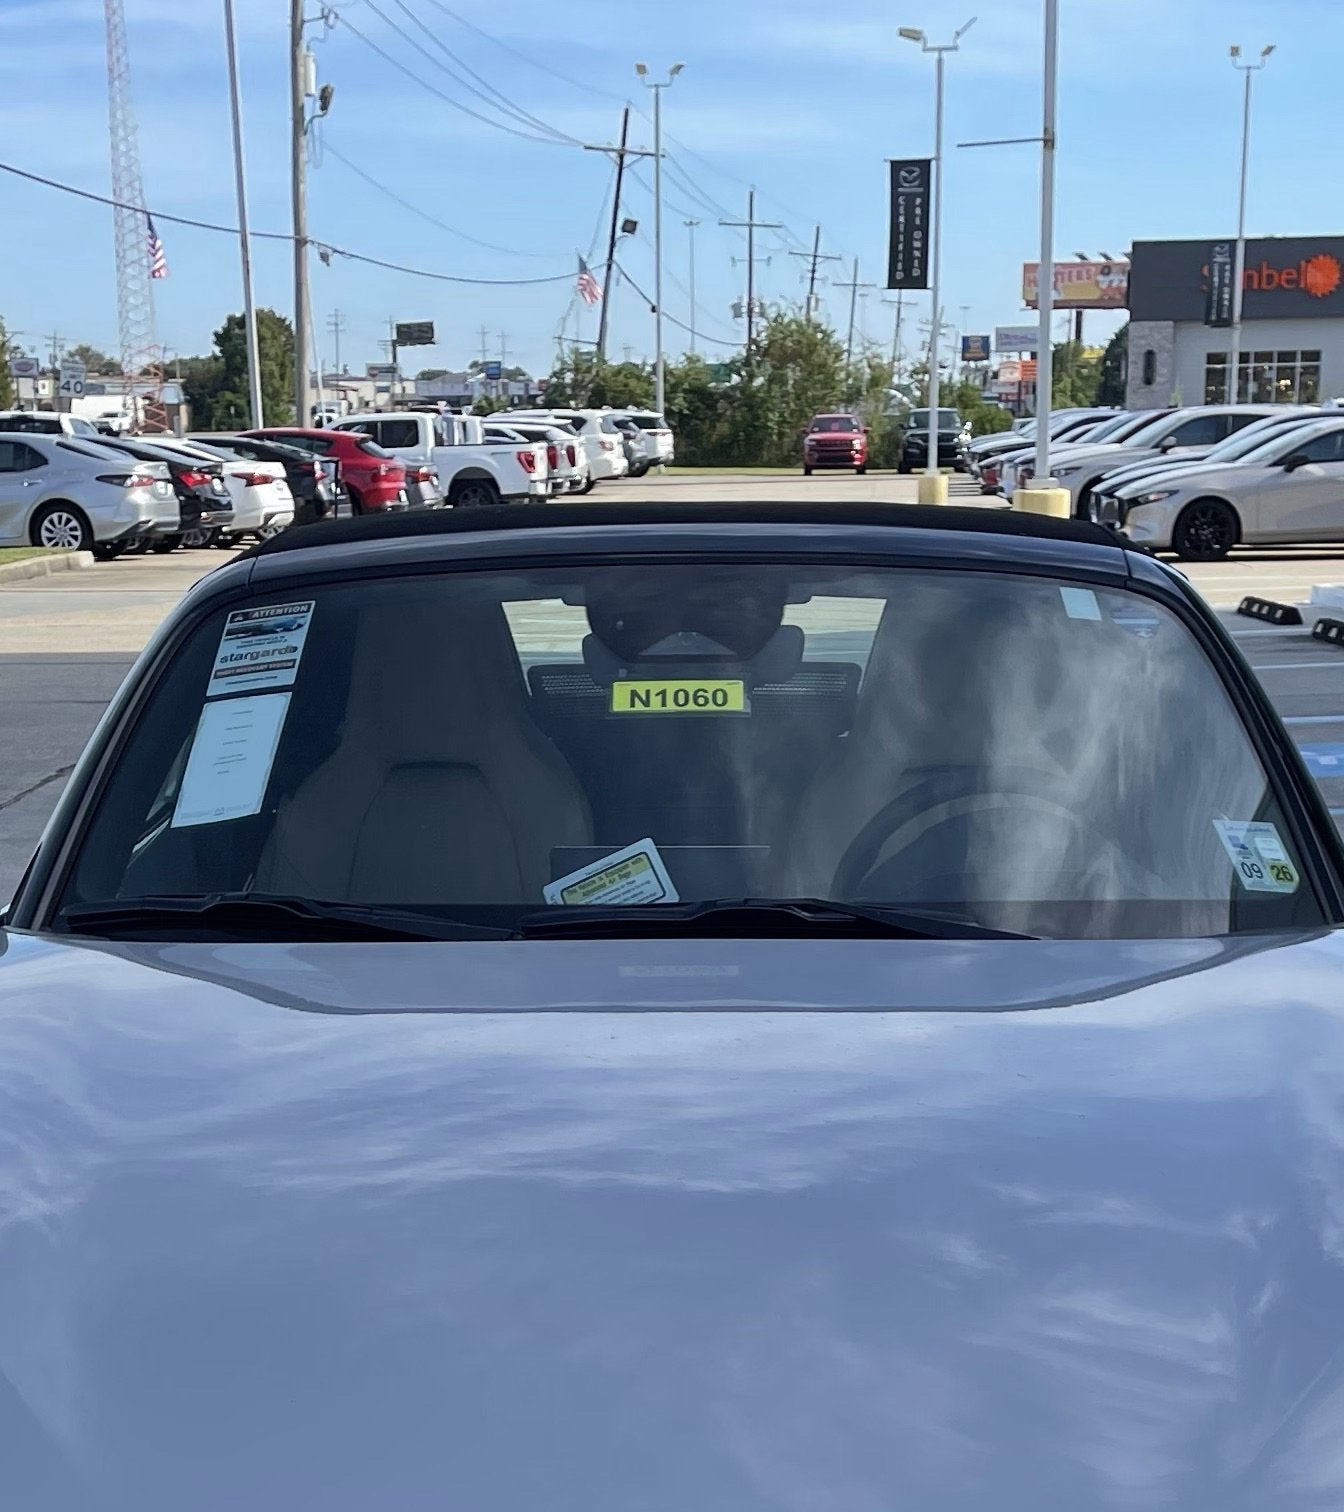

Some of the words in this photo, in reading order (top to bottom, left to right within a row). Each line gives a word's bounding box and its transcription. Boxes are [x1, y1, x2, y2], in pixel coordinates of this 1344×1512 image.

[60, 380, 84, 394] 40
[251, 604, 309, 619] ATTENTION
[629, 688, 729, 709] N1060
[1240, 861, 1264, 879] 09
[1270, 864, 1294, 882] 26
